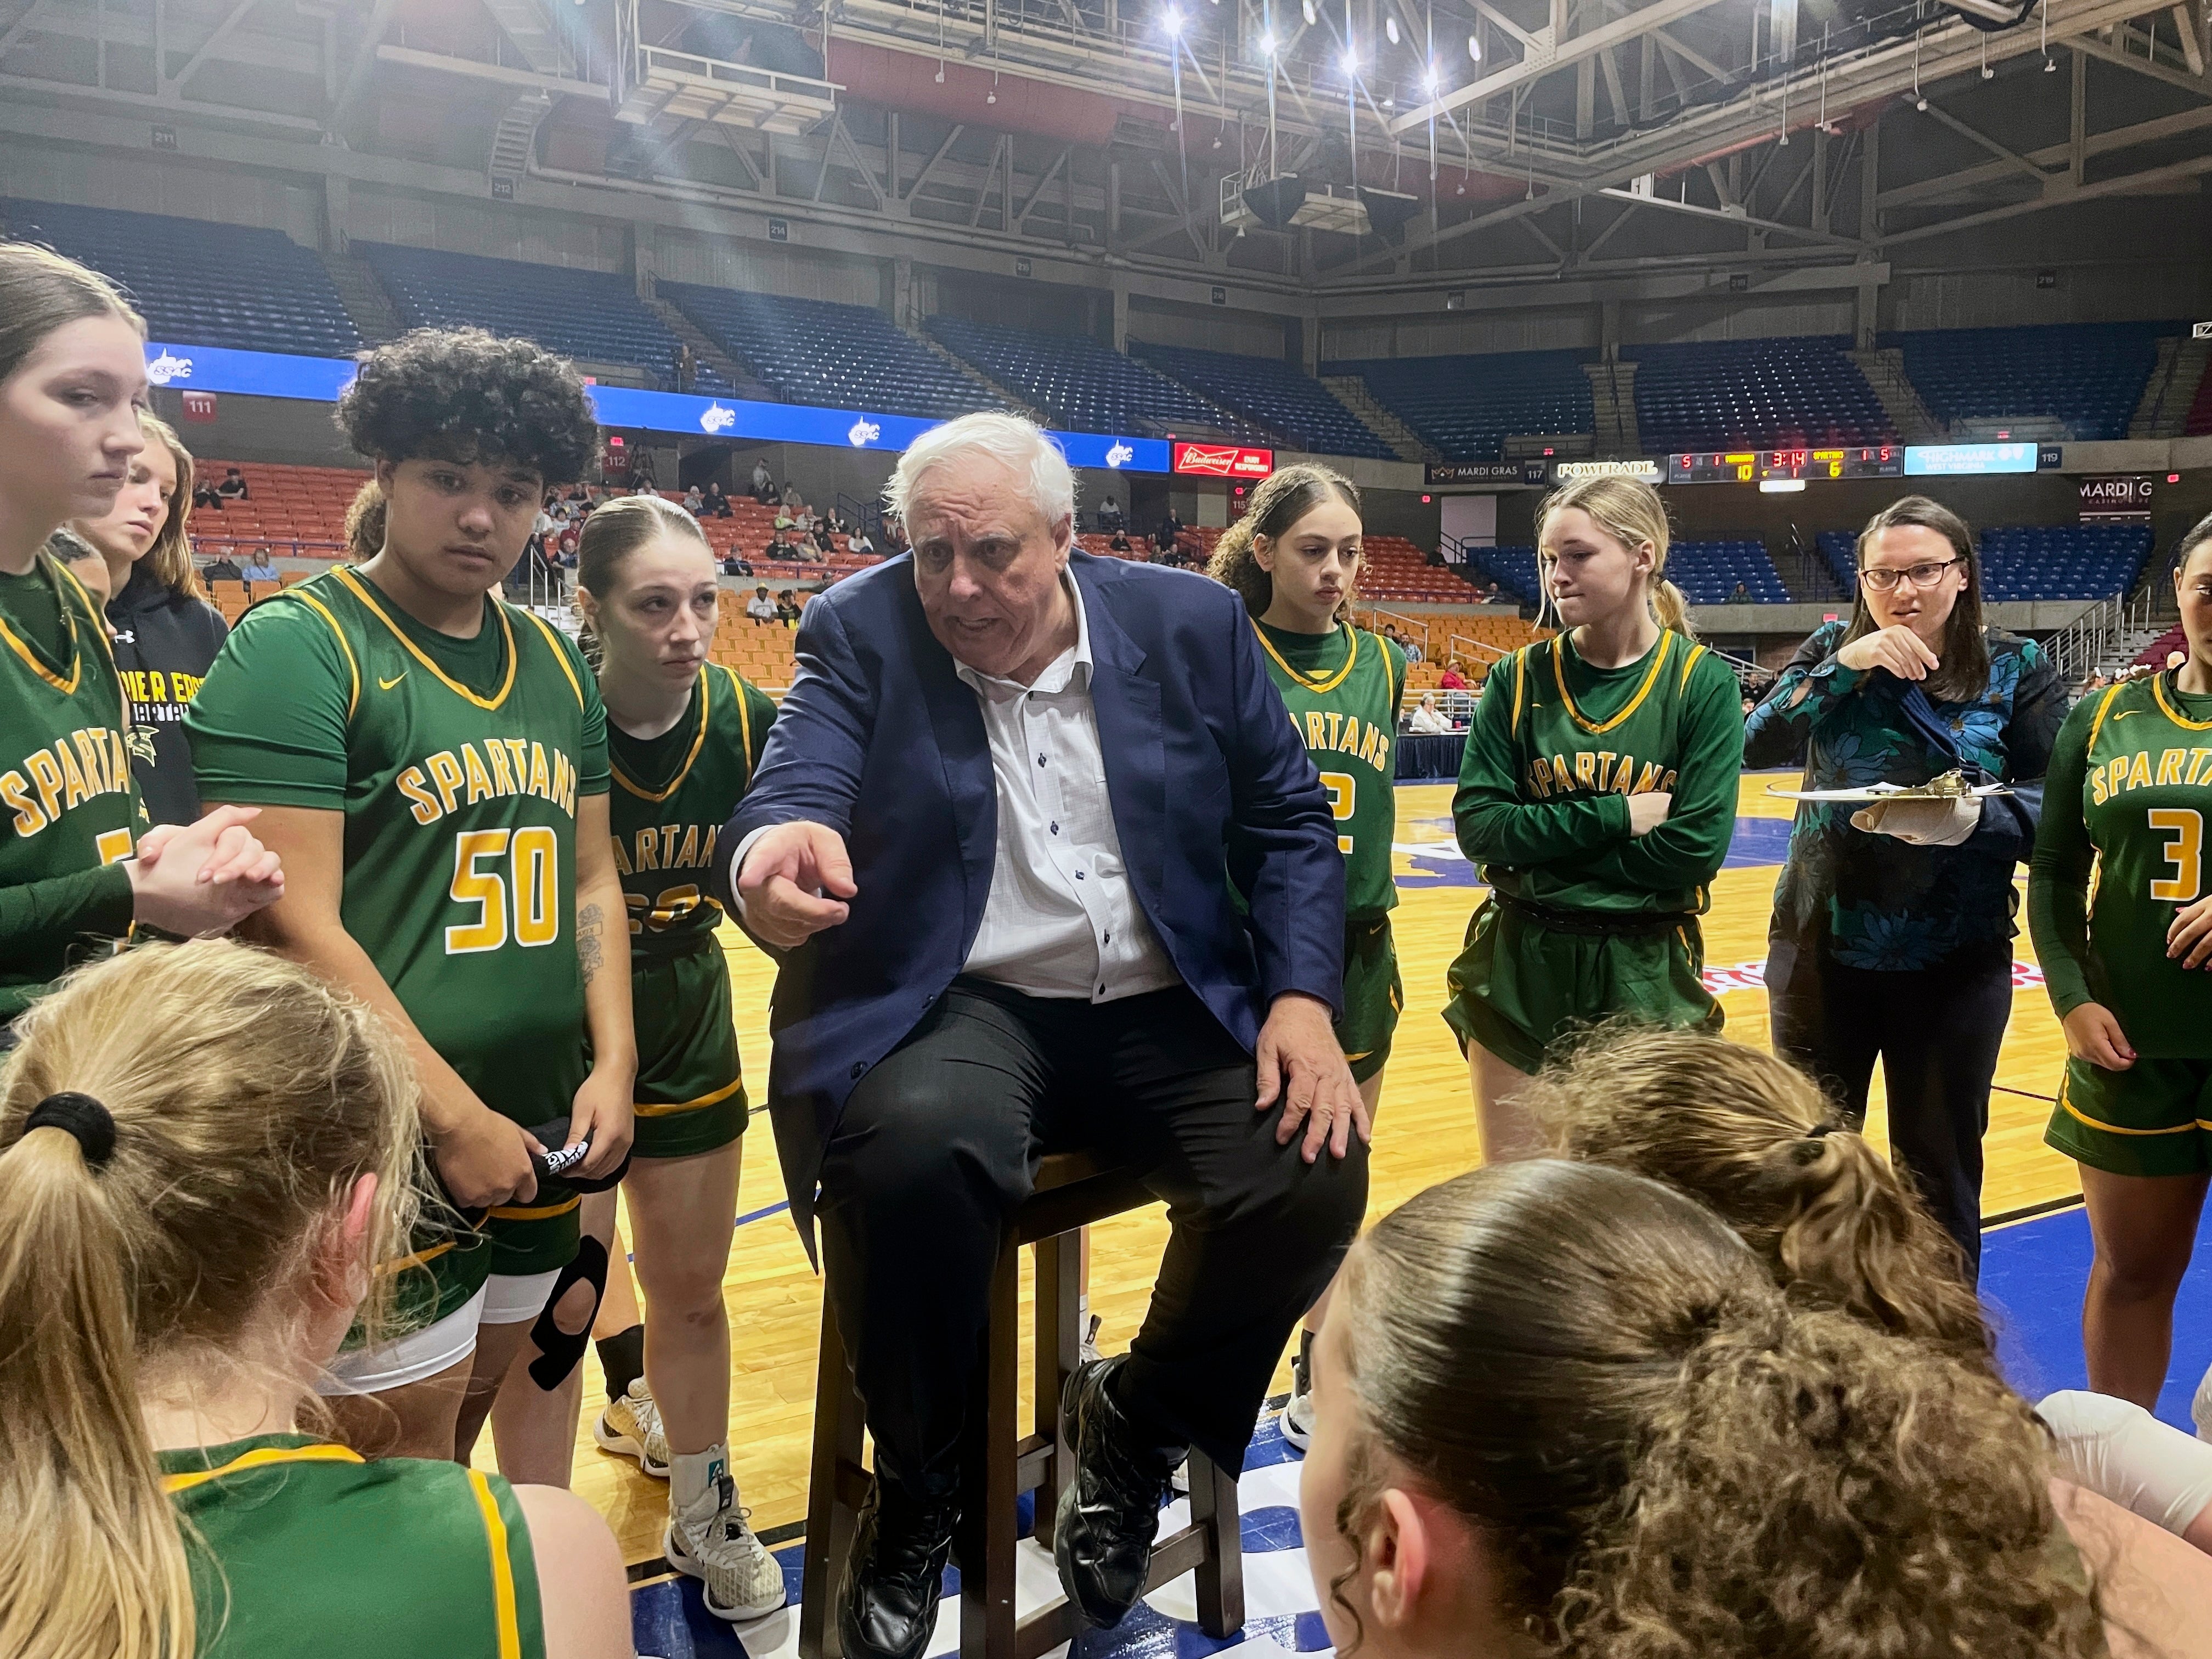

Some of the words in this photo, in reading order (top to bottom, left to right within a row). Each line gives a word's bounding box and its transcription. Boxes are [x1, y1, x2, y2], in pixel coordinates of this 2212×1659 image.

[770, 225, 785, 235] 214
[189, 400, 211, 414] 111
[609, 456, 625, 466] 112
[1184, 452, 1232, 466] Budweiser
[1773, 452, 1805, 467] 3:14
[1925, 450, 1995, 462] HIGHMARK
[2041, 453, 2058, 462] 119
[1457, 467, 1488, 476] MARDI
[1491, 466, 1517, 475] GRAS
[1558, 461, 1657, 478] POWERADE
[1737, 464, 1752, 481] 10
[1829, 461, 1840, 478] 6
[1926, 462, 1945, 471] WEST
[1947, 461, 1985, 470] VIRGINIA
[1527, 470, 1543, 479] 117
[2080, 482, 2132, 497] MARDI
[1233, 501, 1246, 509] 115
[396, 738, 576, 825] SPARTANS
[2147, 808, 2203, 901] 3
[445, 826, 558, 955] 50
